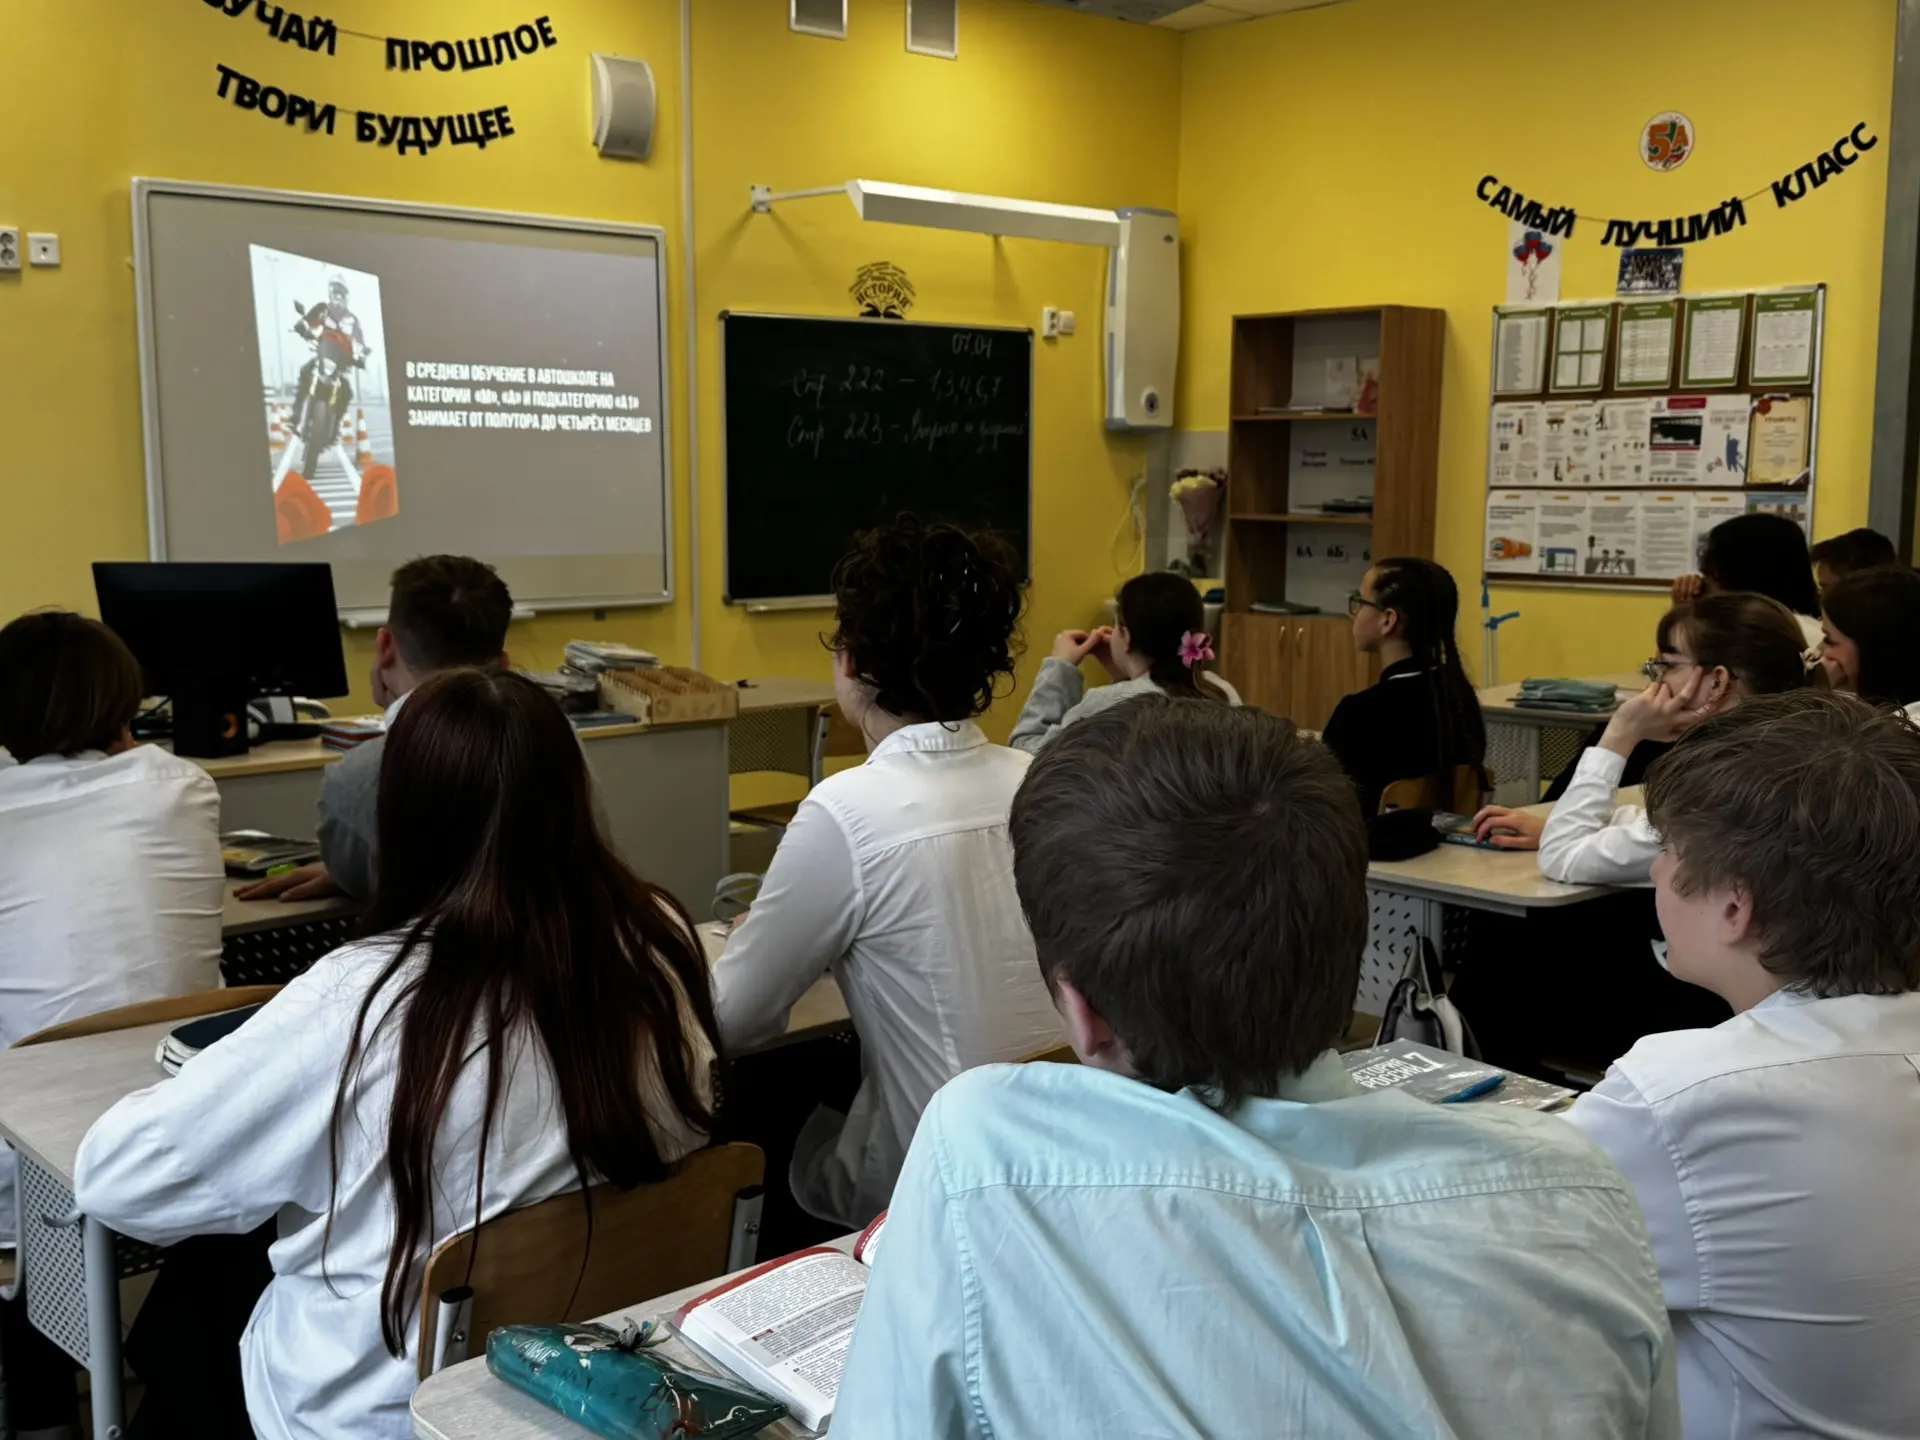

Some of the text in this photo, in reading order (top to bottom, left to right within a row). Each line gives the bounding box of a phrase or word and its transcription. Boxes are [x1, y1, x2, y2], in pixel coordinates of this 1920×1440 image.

[202, 0, 557, 72] УЧАЙ ПРОШЛОЕ
[215, 64, 515, 155] ТВОРИ БУДУЩЕЕ
[1476, 122, 1878, 247] САМЫЙ ЛУЧШИЙ КЛАСС
[856, 283, 909, 307] ИСТОРИЯ
[406, 361, 615, 388] В СРЕДНЕМ ОБУЧЕНИЕ В АВТОШКОЛЕ НА
[840, 364, 884, 393] 222
[407, 384, 471, 404] КАТЕГОРИИ
[523, 390, 531, 406] И
[532, 390, 614, 410] ПОДКАТЕГОРИЮ
[408, 408, 652, 434] ЗАНИМАЕТ ОТ ПОЛУТОРА ДО ЧЕТЫРЁХ МЕСЯЦЕВ
[844, 412, 883, 445] 223
[1360, 1065, 1422, 1089] РОССИИ
